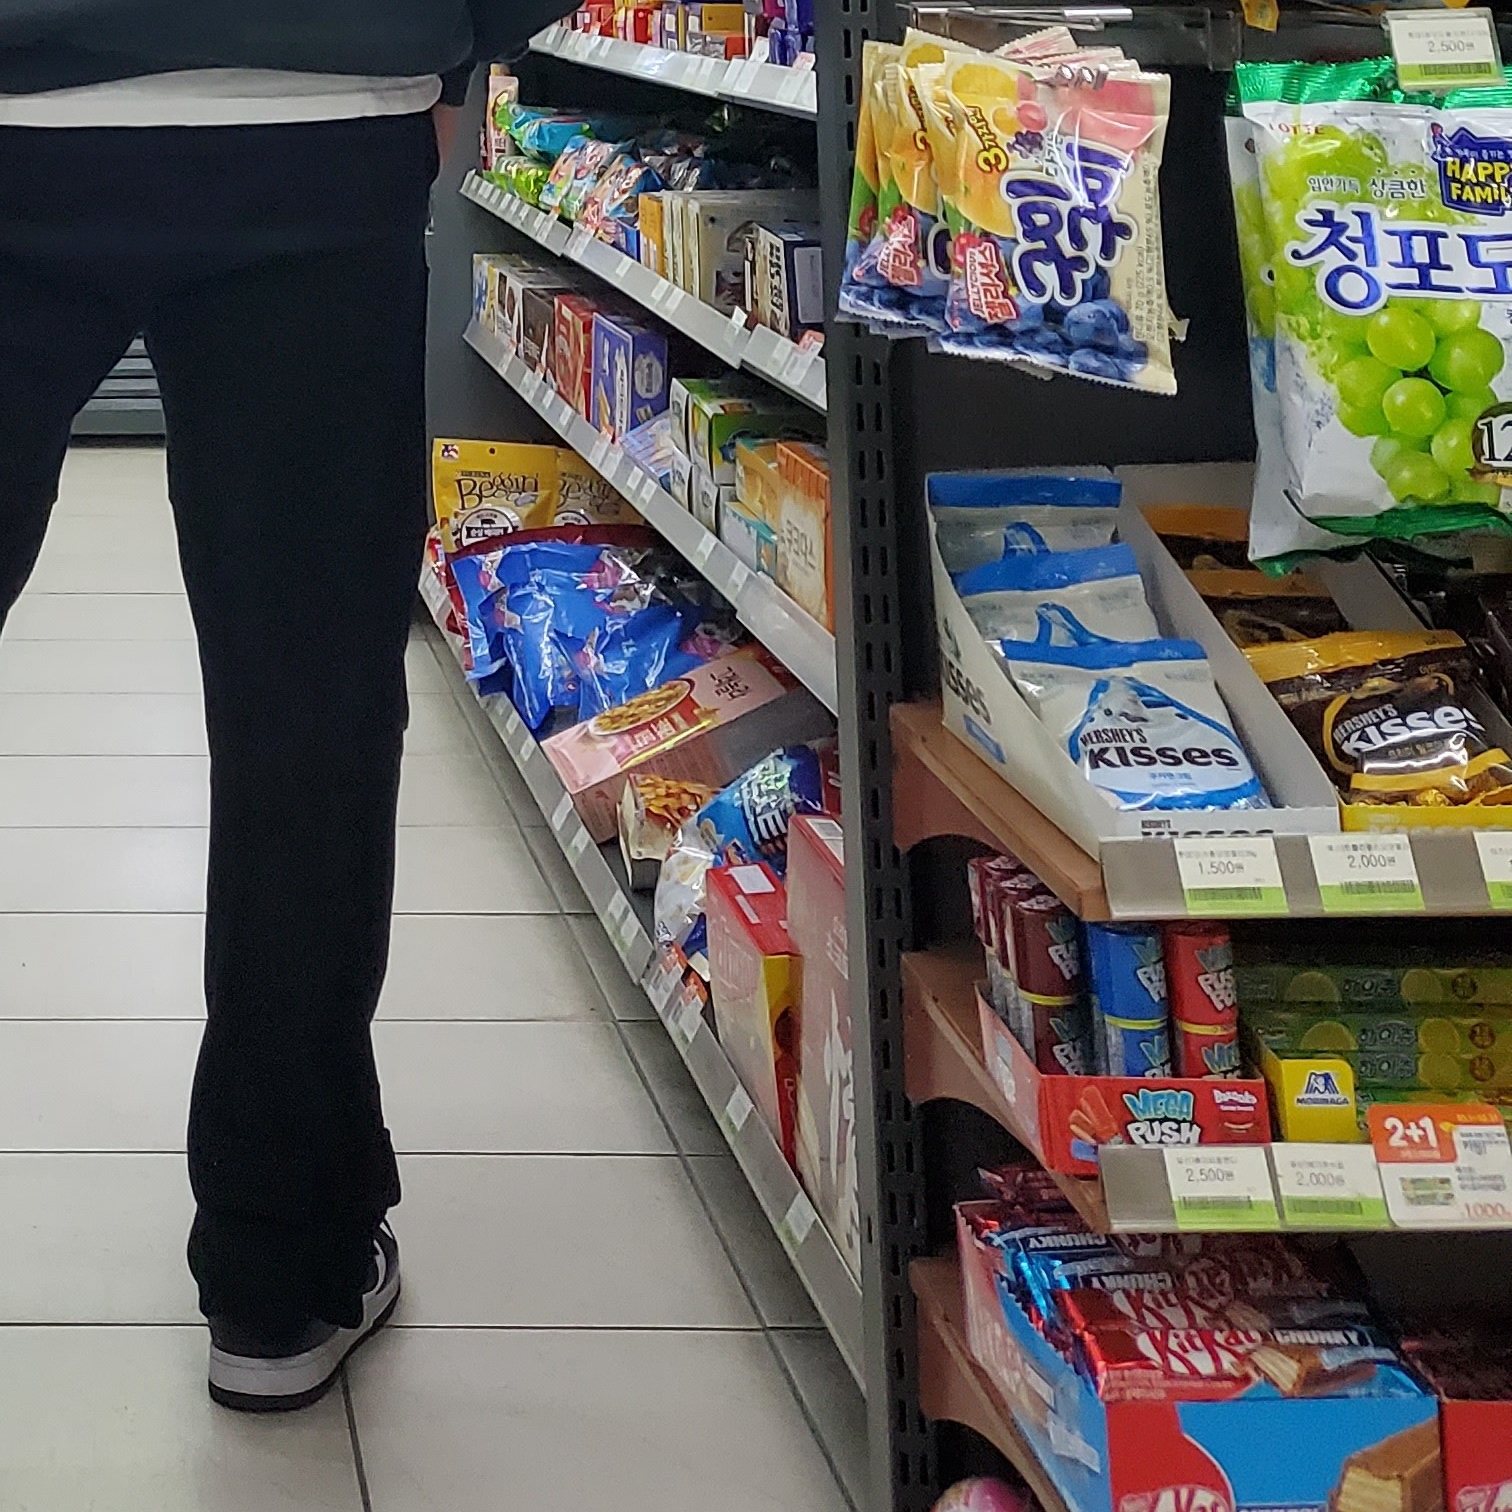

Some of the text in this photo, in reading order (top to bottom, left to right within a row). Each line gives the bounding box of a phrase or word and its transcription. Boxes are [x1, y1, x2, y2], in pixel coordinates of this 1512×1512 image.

[1445, 159, 1512, 185] HAPP
[1368, 176, 1427, 200] 상큼한
[1331, 703, 1398, 742] HERSHEY'S
[1079, 727, 1148, 747] HERSHEY'S
[1199, 861, 1245, 875] 1,500원
[1348, 854, 1397, 869] 2,000원
[1123, 1088, 1194, 1121] MEGA
[1127, 1120, 1202, 1145] PUSH
[1383, 1116, 1437, 1148] 2+1
[1185, 1167, 1235, 1183] 2,500원
[1274, 1329, 1362, 1346] CHUNKY
